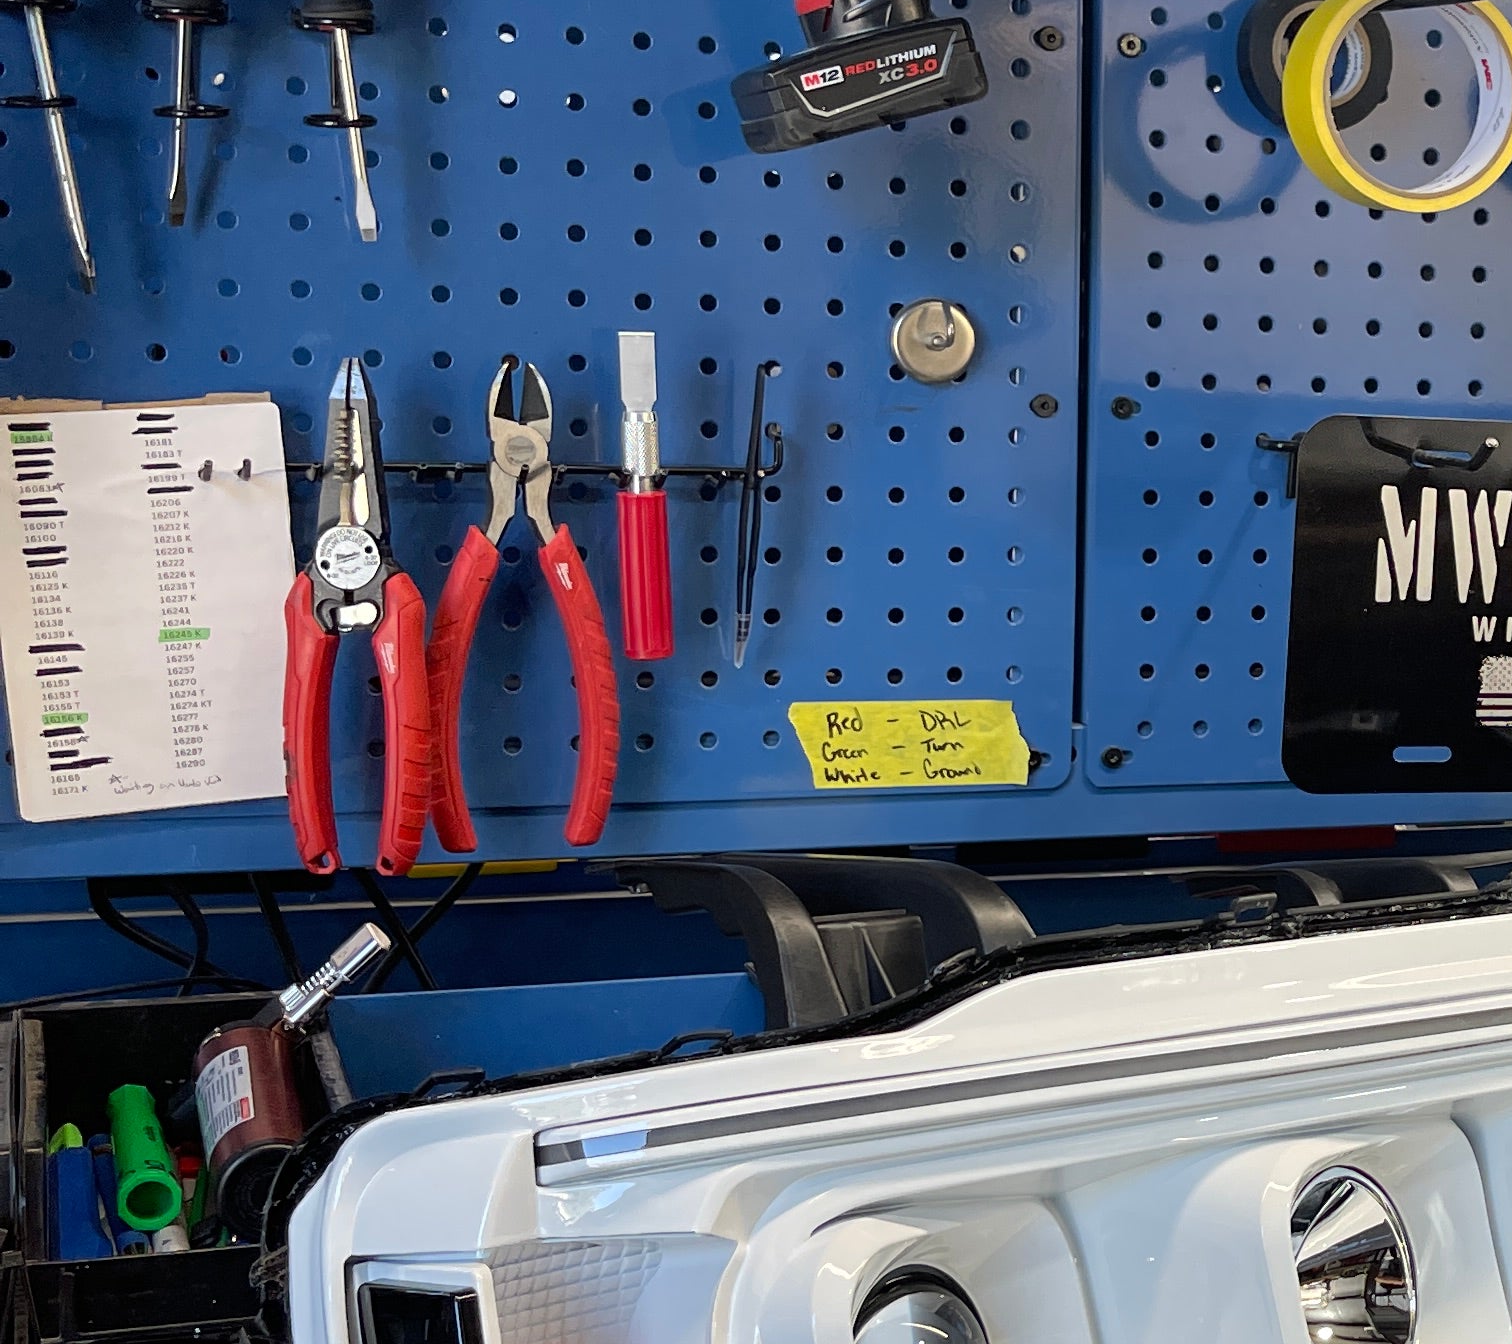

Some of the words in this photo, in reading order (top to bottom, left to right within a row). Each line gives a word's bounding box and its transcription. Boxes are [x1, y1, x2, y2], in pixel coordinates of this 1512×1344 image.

[804, 69, 841, 87] M12
[845, 44, 936, 77] REDLITHIUM
[1480, 58, 1493, 91] 3M
[157, 559, 185, 569] 16222
[160, 594, 188, 605] 16237
[162, 606, 191, 616] 16241
[163, 618, 192, 628] 16244
[165, 642, 193, 652] 16247
[168, 678, 197, 688] 16270
[169, 690, 197, 700] 16274
[170, 701, 199, 711] 16274
[826, 707, 864, 738] Red
[919, 709, 972, 732] DRL
[821, 742, 869, 762] Green
[920, 737, 964, 754] Turn
[823, 767, 881, 784] White
[923, 758, 982, 779] Ground
